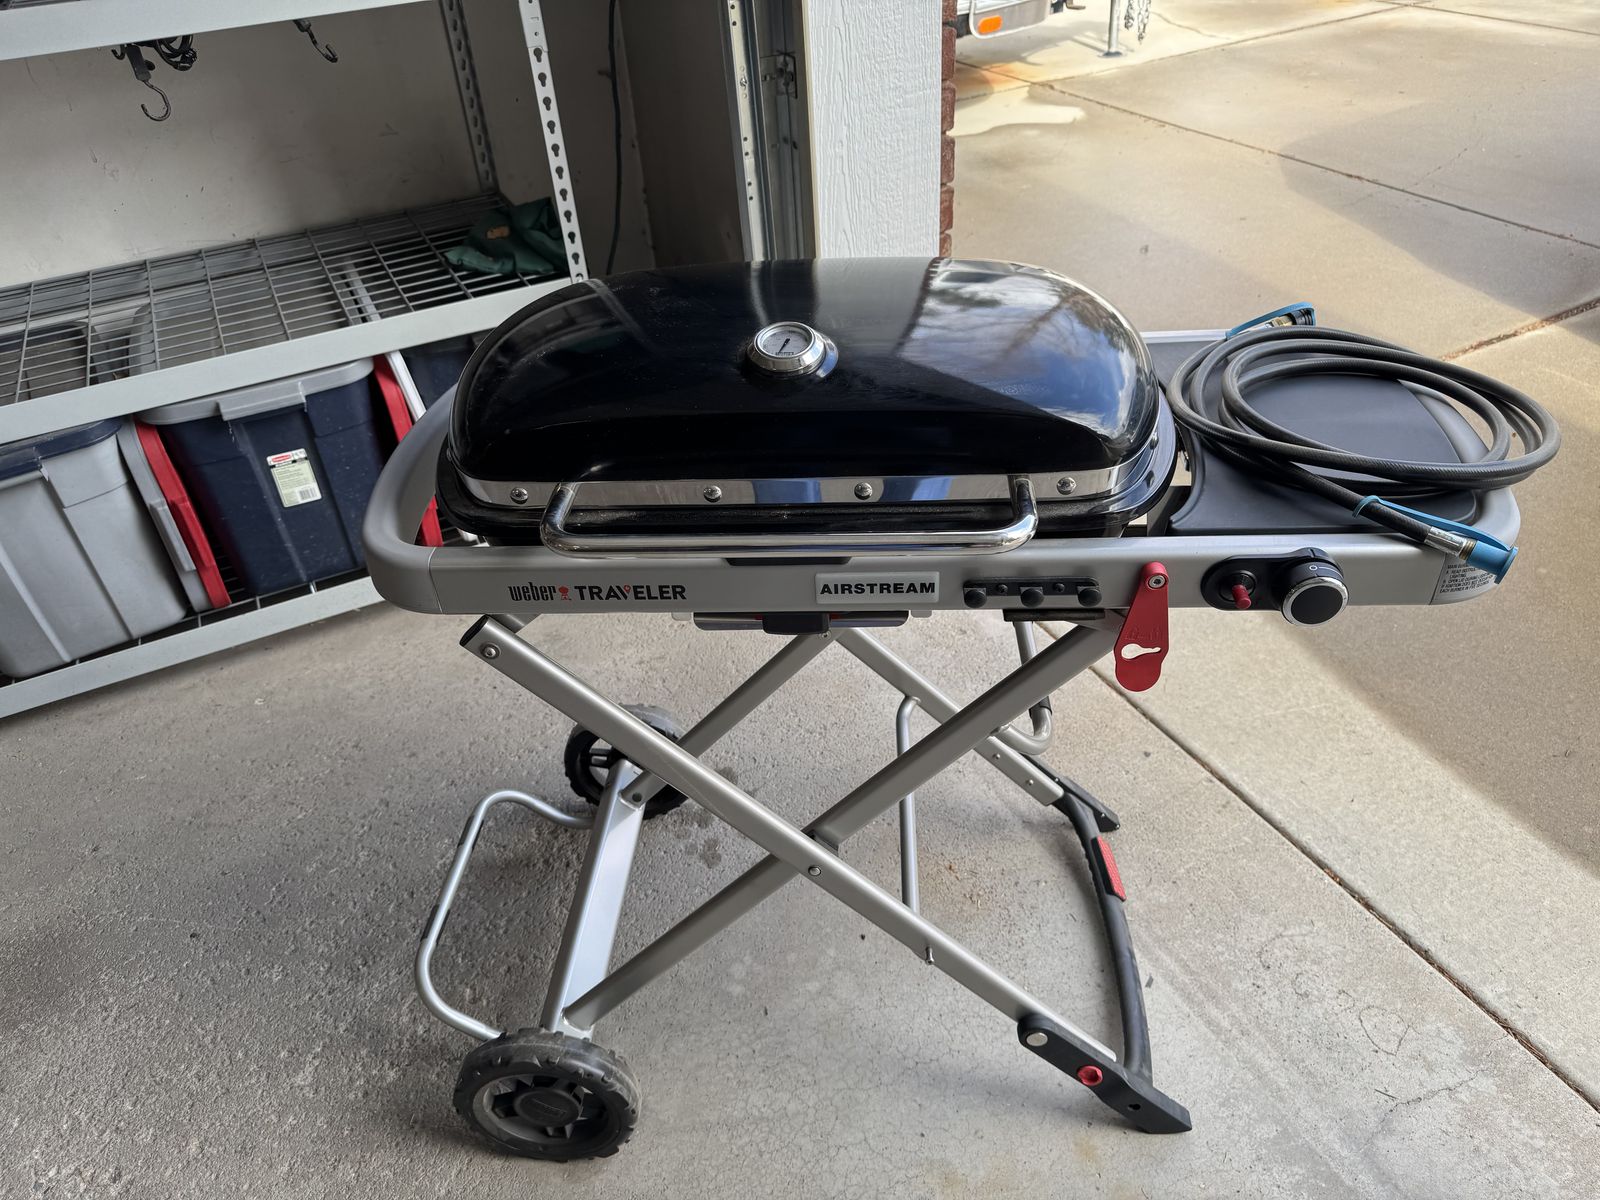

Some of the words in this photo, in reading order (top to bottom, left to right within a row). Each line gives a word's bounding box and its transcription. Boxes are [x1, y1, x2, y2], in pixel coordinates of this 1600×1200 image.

[508, 582, 556, 601] weber
[574, 584, 687, 600] TRAVELER
[820, 582, 935, 594] AIRSTREAM
